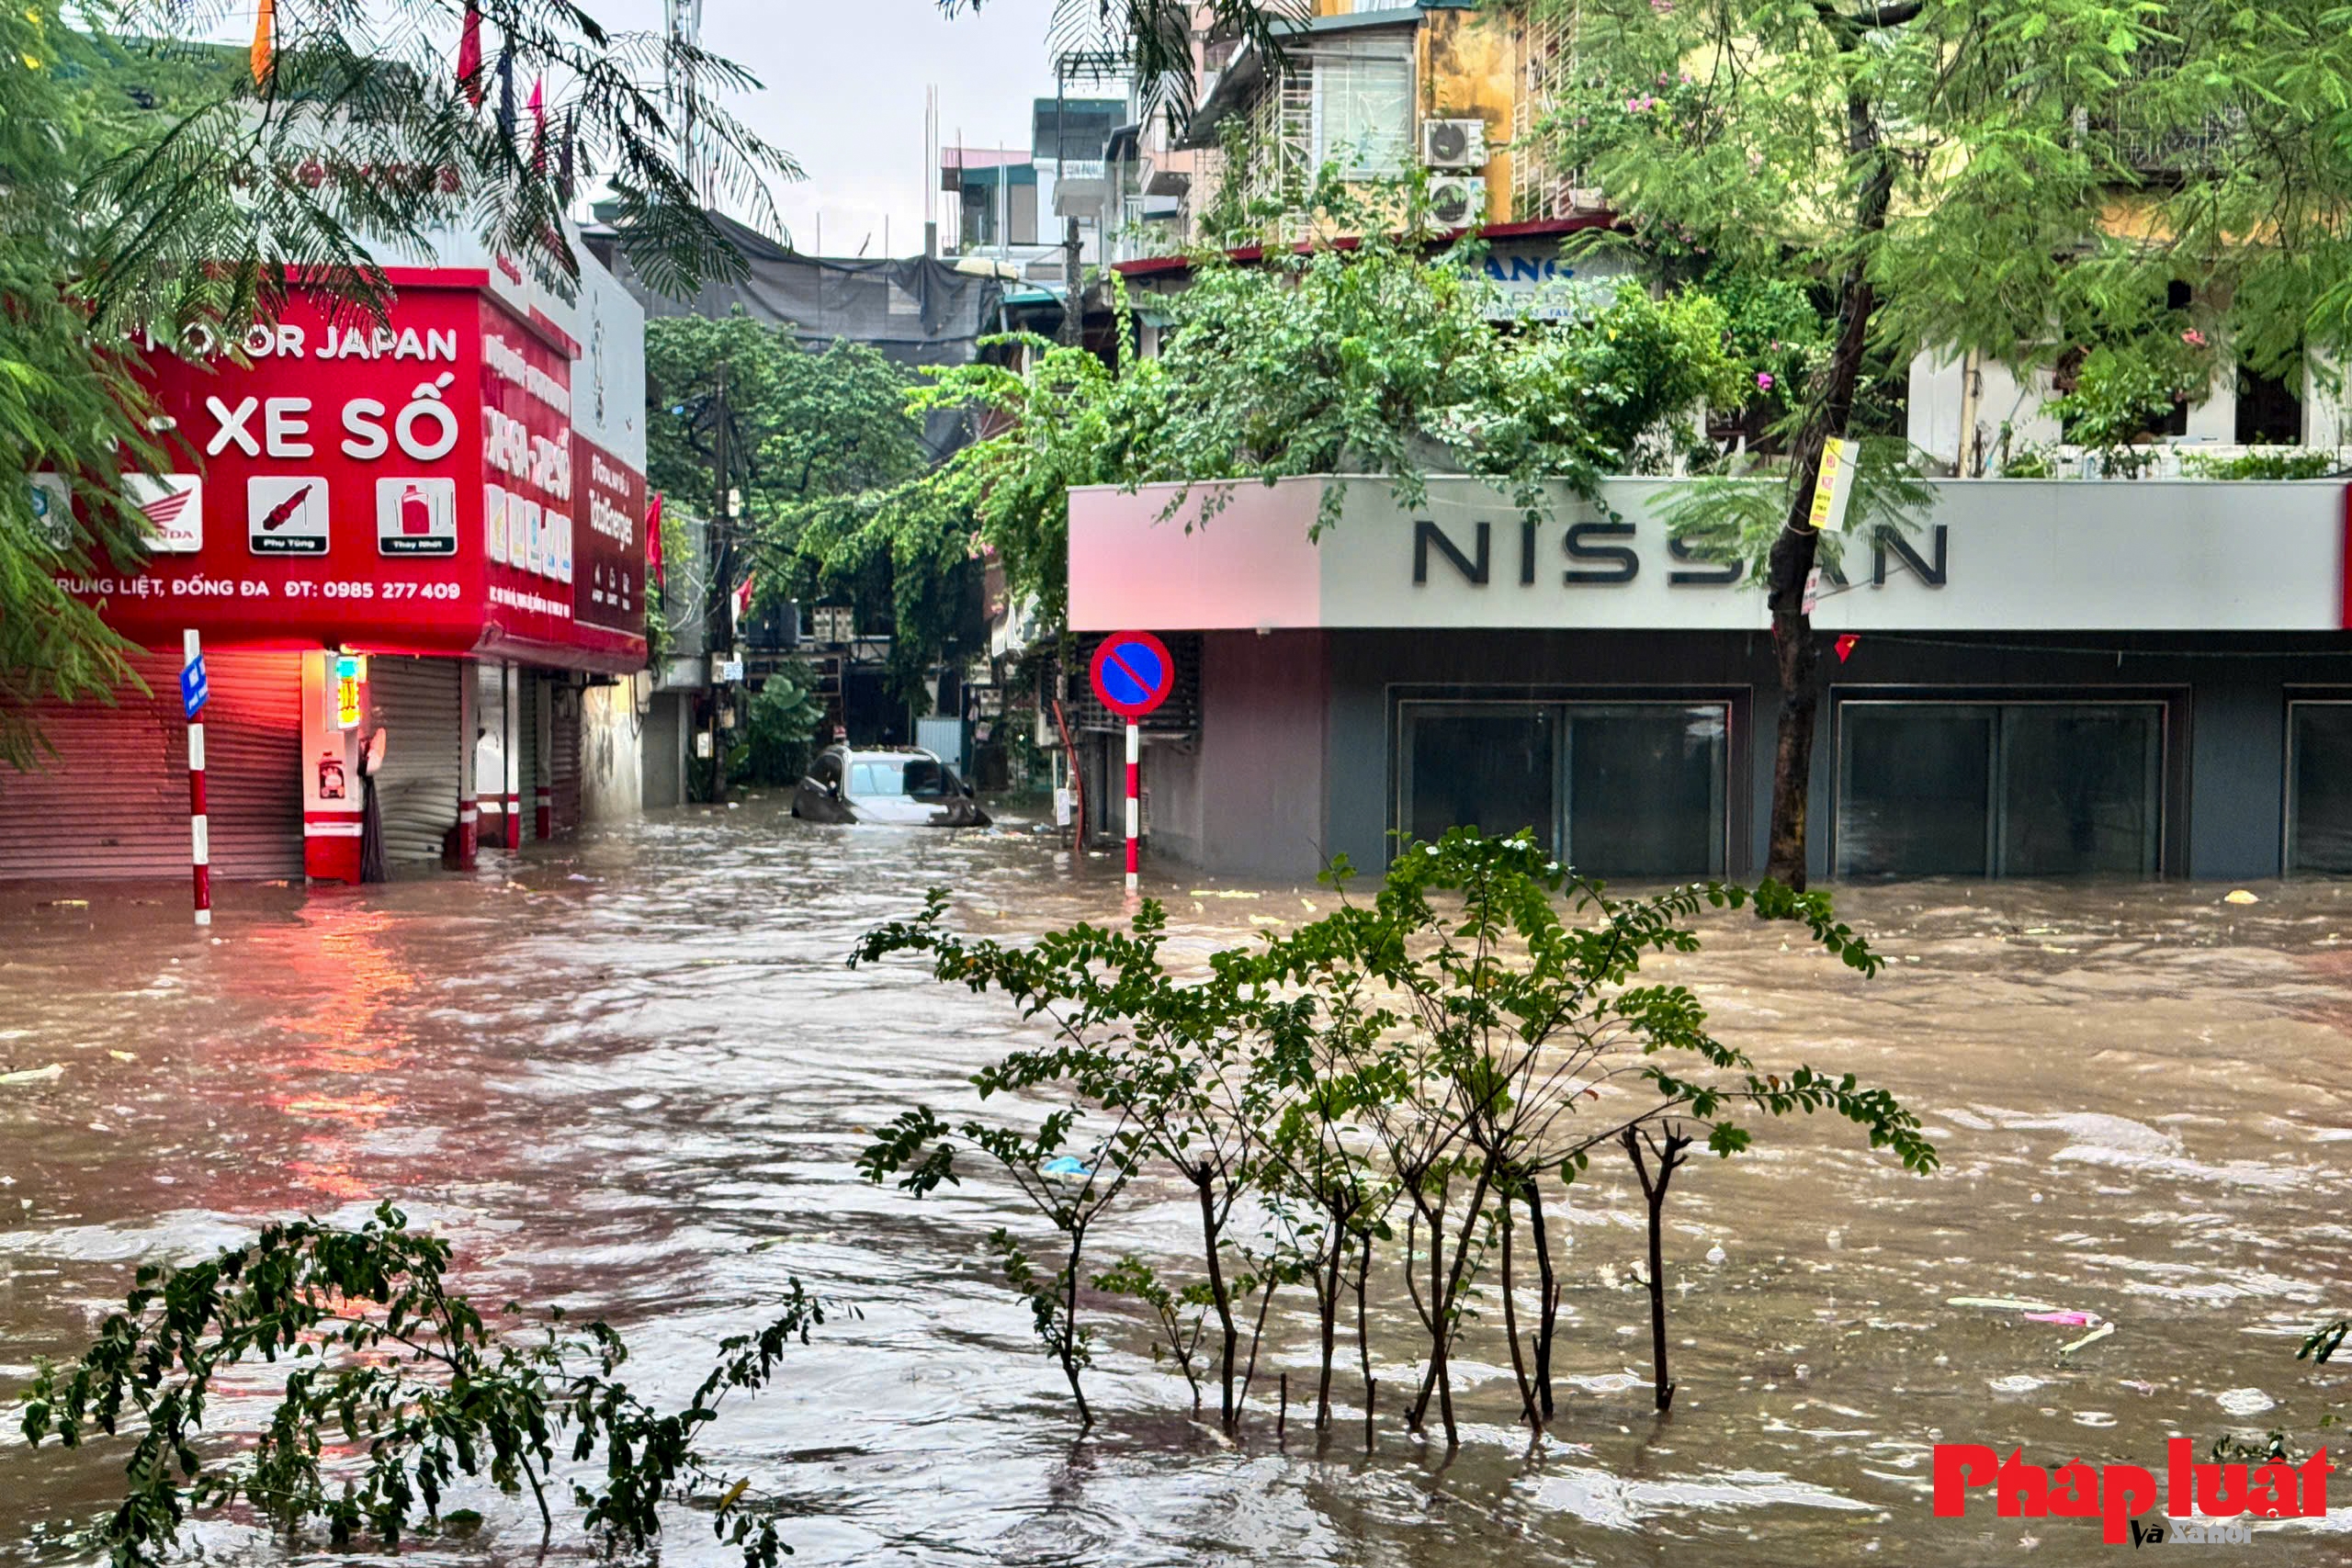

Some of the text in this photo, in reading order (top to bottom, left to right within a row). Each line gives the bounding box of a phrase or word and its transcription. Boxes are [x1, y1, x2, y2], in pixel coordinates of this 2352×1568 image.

[316, 325, 458, 362] JAPAN
[206, 396, 314, 457] XE
[341, 371, 459, 461] SỐ
[1412, 521, 1948, 587] NISSN
[119, 575, 166, 600] LIỆT,
[172, 572, 234, 596] ĐỐNG
[240, 581, 270, 597] ĐA
[284, 581, 319, 598] ĐT:
[323, 581, 375, 598] 0985
[381, 581, 419, 600] 277
[420, 582, 461, 600] 409
